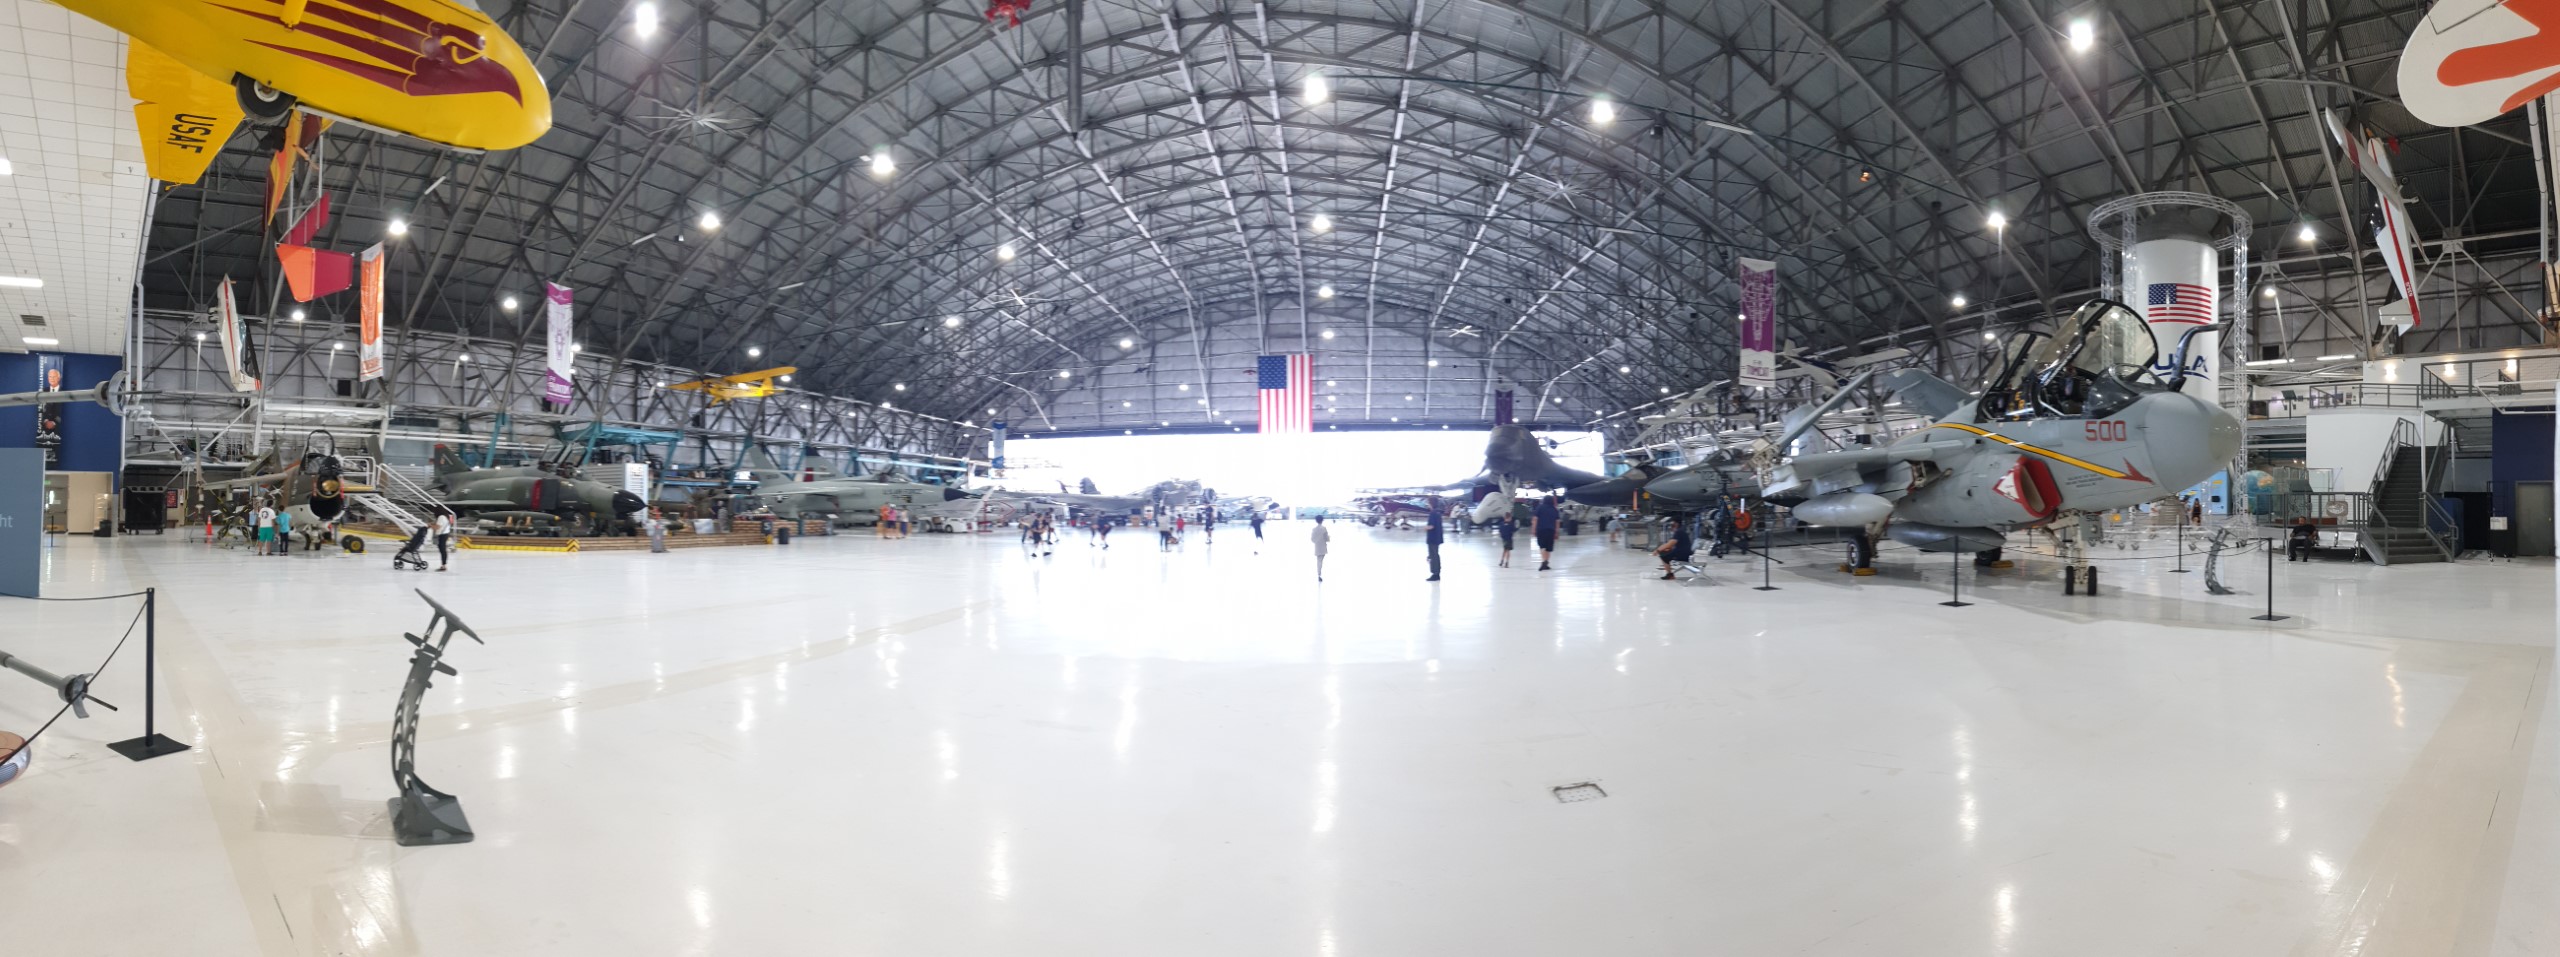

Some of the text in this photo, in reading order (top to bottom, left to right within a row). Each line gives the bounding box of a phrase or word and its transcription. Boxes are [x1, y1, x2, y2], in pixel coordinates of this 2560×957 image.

[166, 113, 218, 154] USAF
[2154, 353, 2208, 373] UA
[2085, 420, 2127, 441] 500
